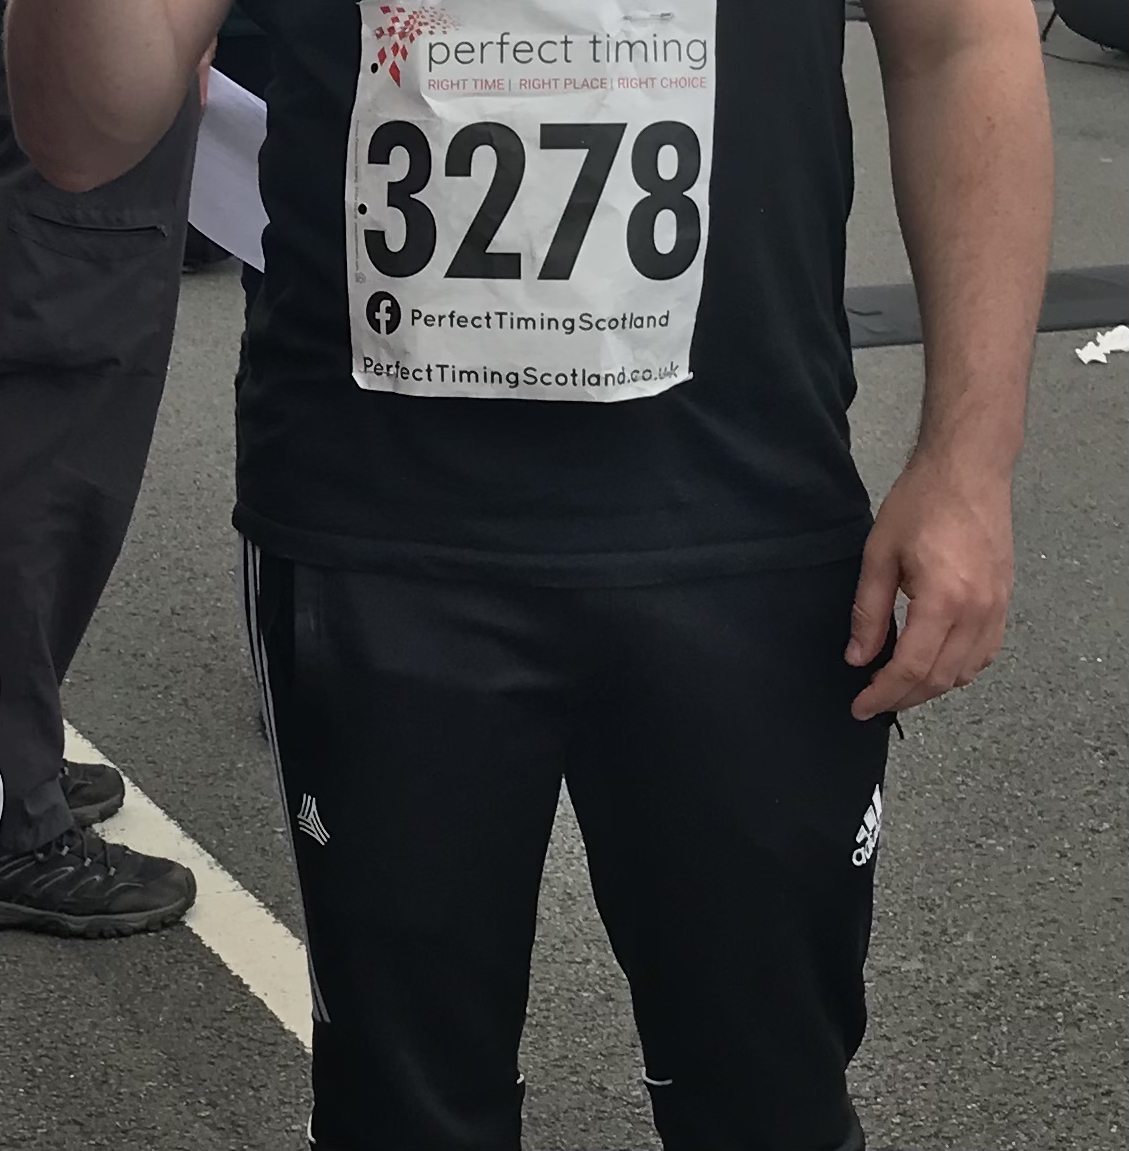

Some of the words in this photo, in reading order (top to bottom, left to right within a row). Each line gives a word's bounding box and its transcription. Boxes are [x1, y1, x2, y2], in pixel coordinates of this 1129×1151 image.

[428, 32, 573, 72] perfect
[588, 33, 708, 70] timing
[427, 78, 469, 91] RIGHT
[472, 78, 505, 90] TIME
[519, 78, 560, 90] RIGHT
[564, 77, 608, 90] PLACE
[617, 77, 657, 89] RIGHT
[660, 76, 707, 89] CHOICE
[363, 120, 701, 282] 3278
[411, 309, 670, 335] PerfectTimingScotland
[362, 357, 679, 388] PerfectTimingScotland.co.uk
